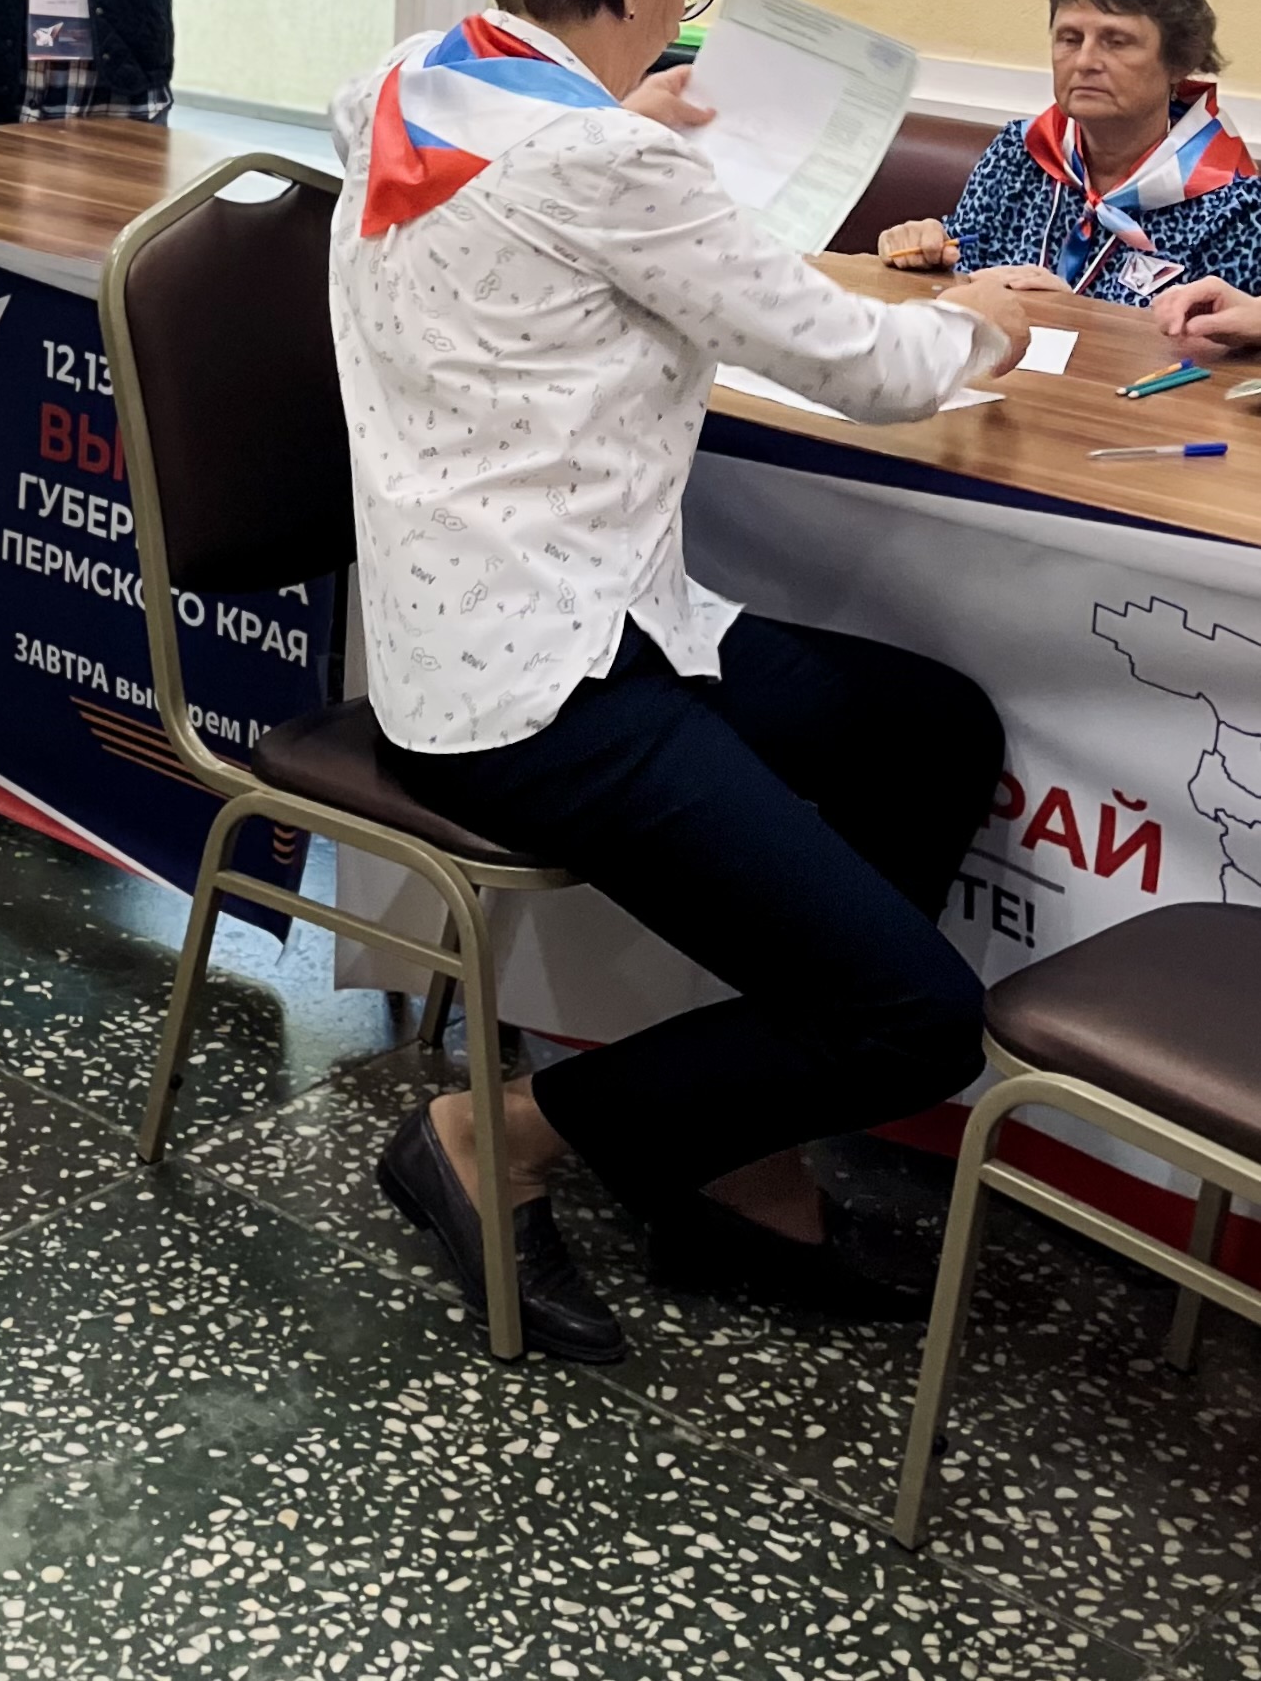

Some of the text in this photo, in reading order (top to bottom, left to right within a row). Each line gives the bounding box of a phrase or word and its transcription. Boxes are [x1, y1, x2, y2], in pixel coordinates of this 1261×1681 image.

[40, 401, 125, 482] ВЫ
[17, 471, 138, 549] ГУБЕР
[0, 528, 310, 668] ПЕРМСКО КРАЯ
[13, 631, 110, 694] ЗАВТРА
[984, 770, 1163, 896] РАЙ
[954, 871, 1036, 949] ТЕ!
